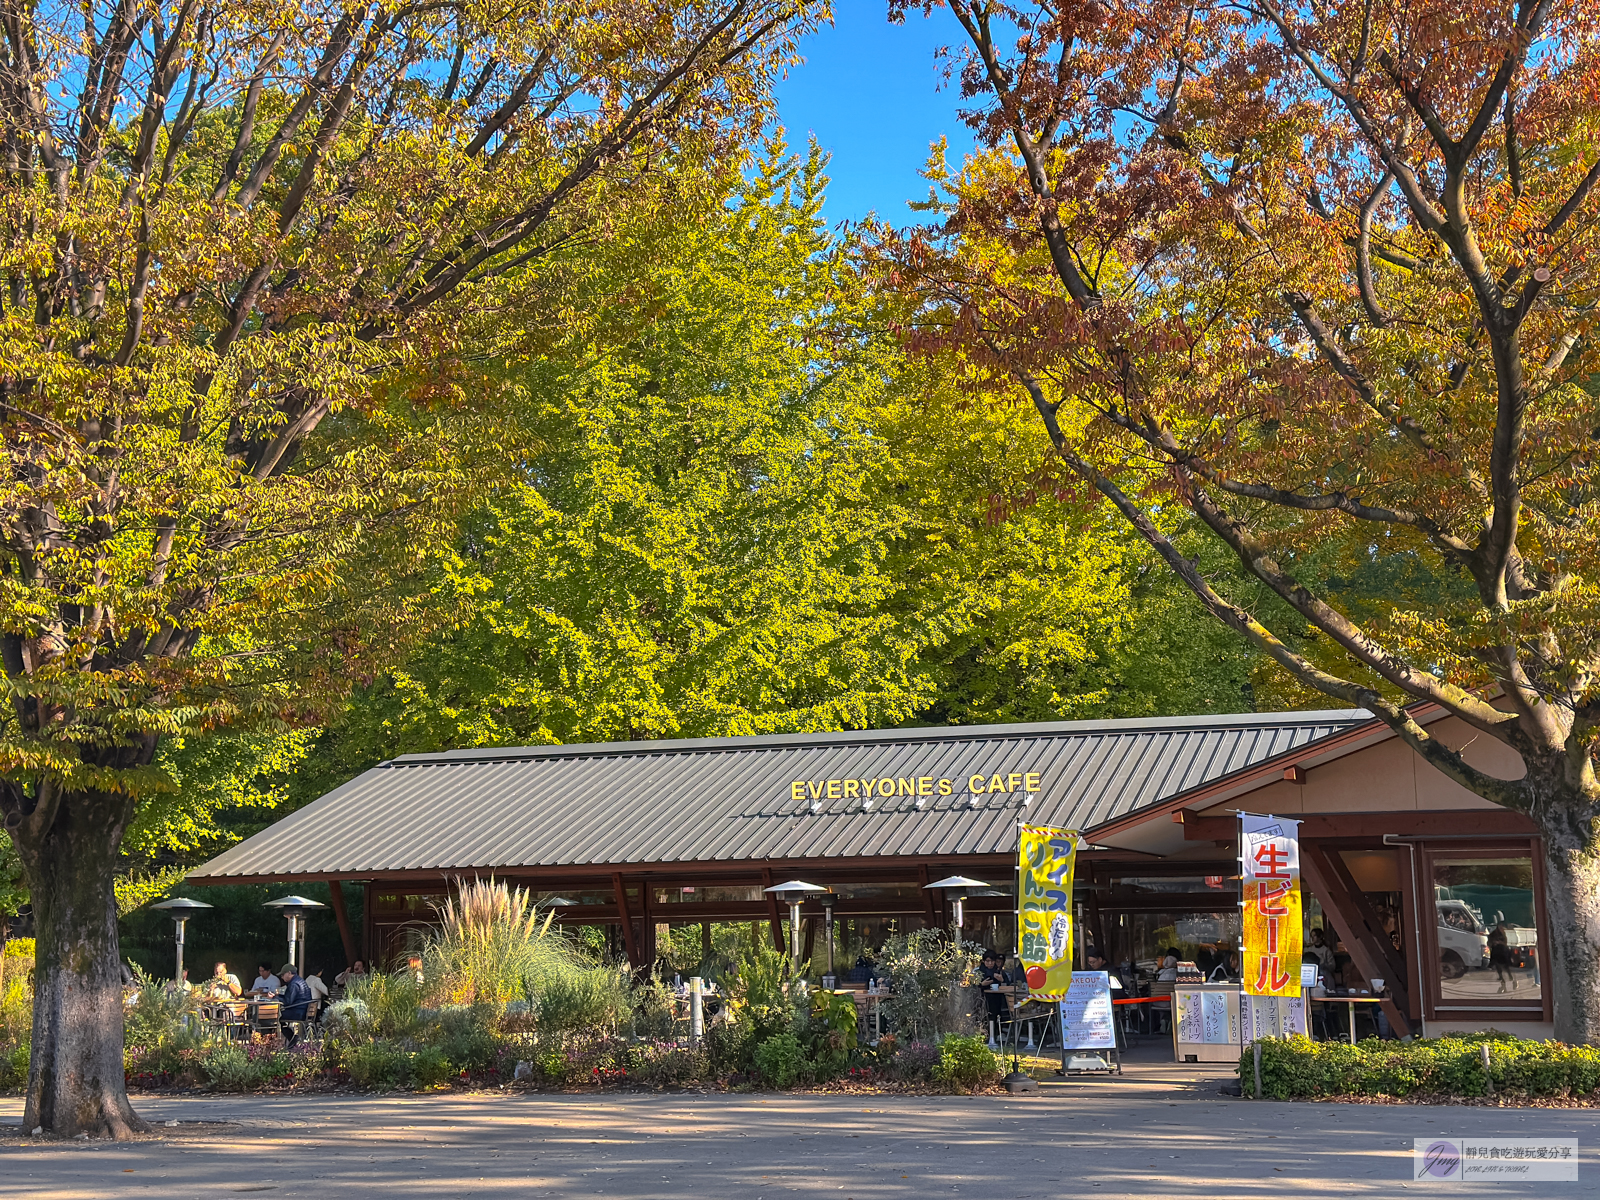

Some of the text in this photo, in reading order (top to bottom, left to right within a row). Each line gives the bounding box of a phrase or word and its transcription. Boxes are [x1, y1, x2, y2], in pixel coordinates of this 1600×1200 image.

[968, 772, 1041, 794] CAFE
[1022, 841, 1047, 963] りんご飴
[1045, 838, 1072, 912] アイス
[1253, 843, 1293, 993] 生ビール
